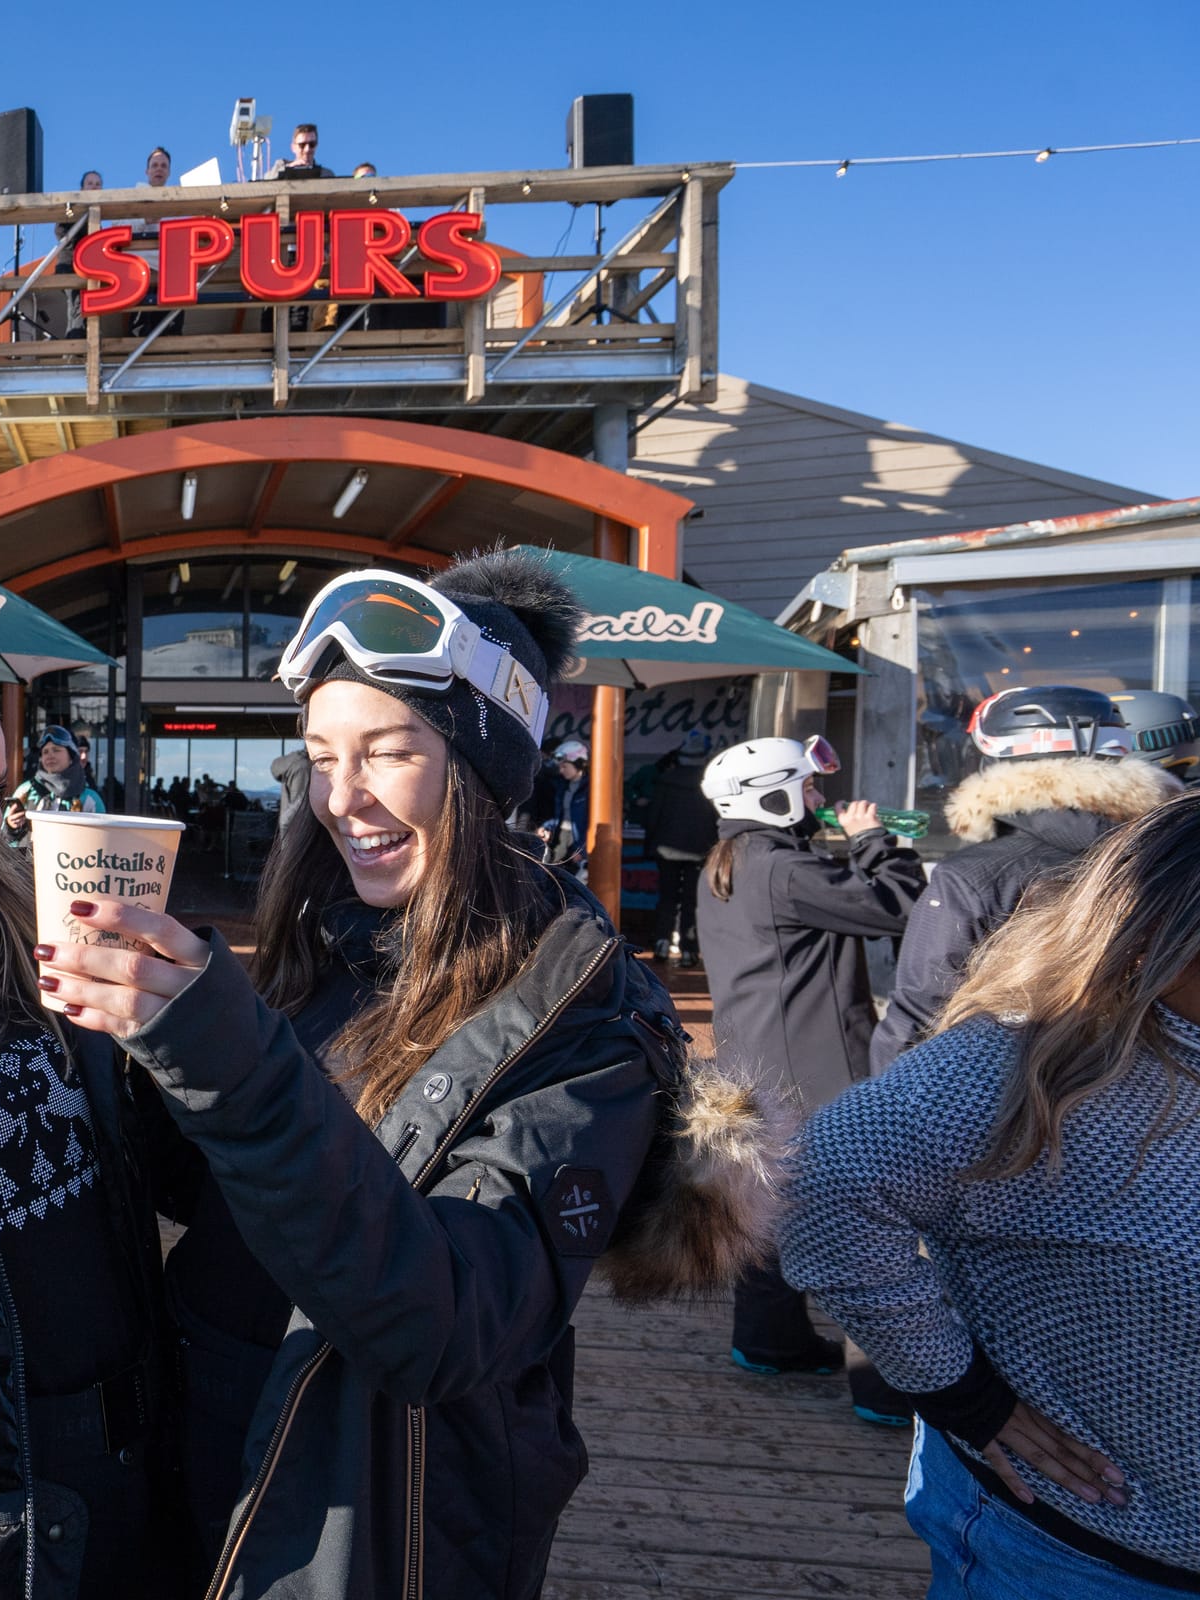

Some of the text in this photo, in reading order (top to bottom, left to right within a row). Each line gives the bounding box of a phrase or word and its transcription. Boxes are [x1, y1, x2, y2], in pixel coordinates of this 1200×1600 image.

[73, 209, 502, 315] SPURS
[580, 605, 716, 640] ails!
[56, 848, 166, 875] Cocktails &
[55, 872, 162, 897] Good Times
